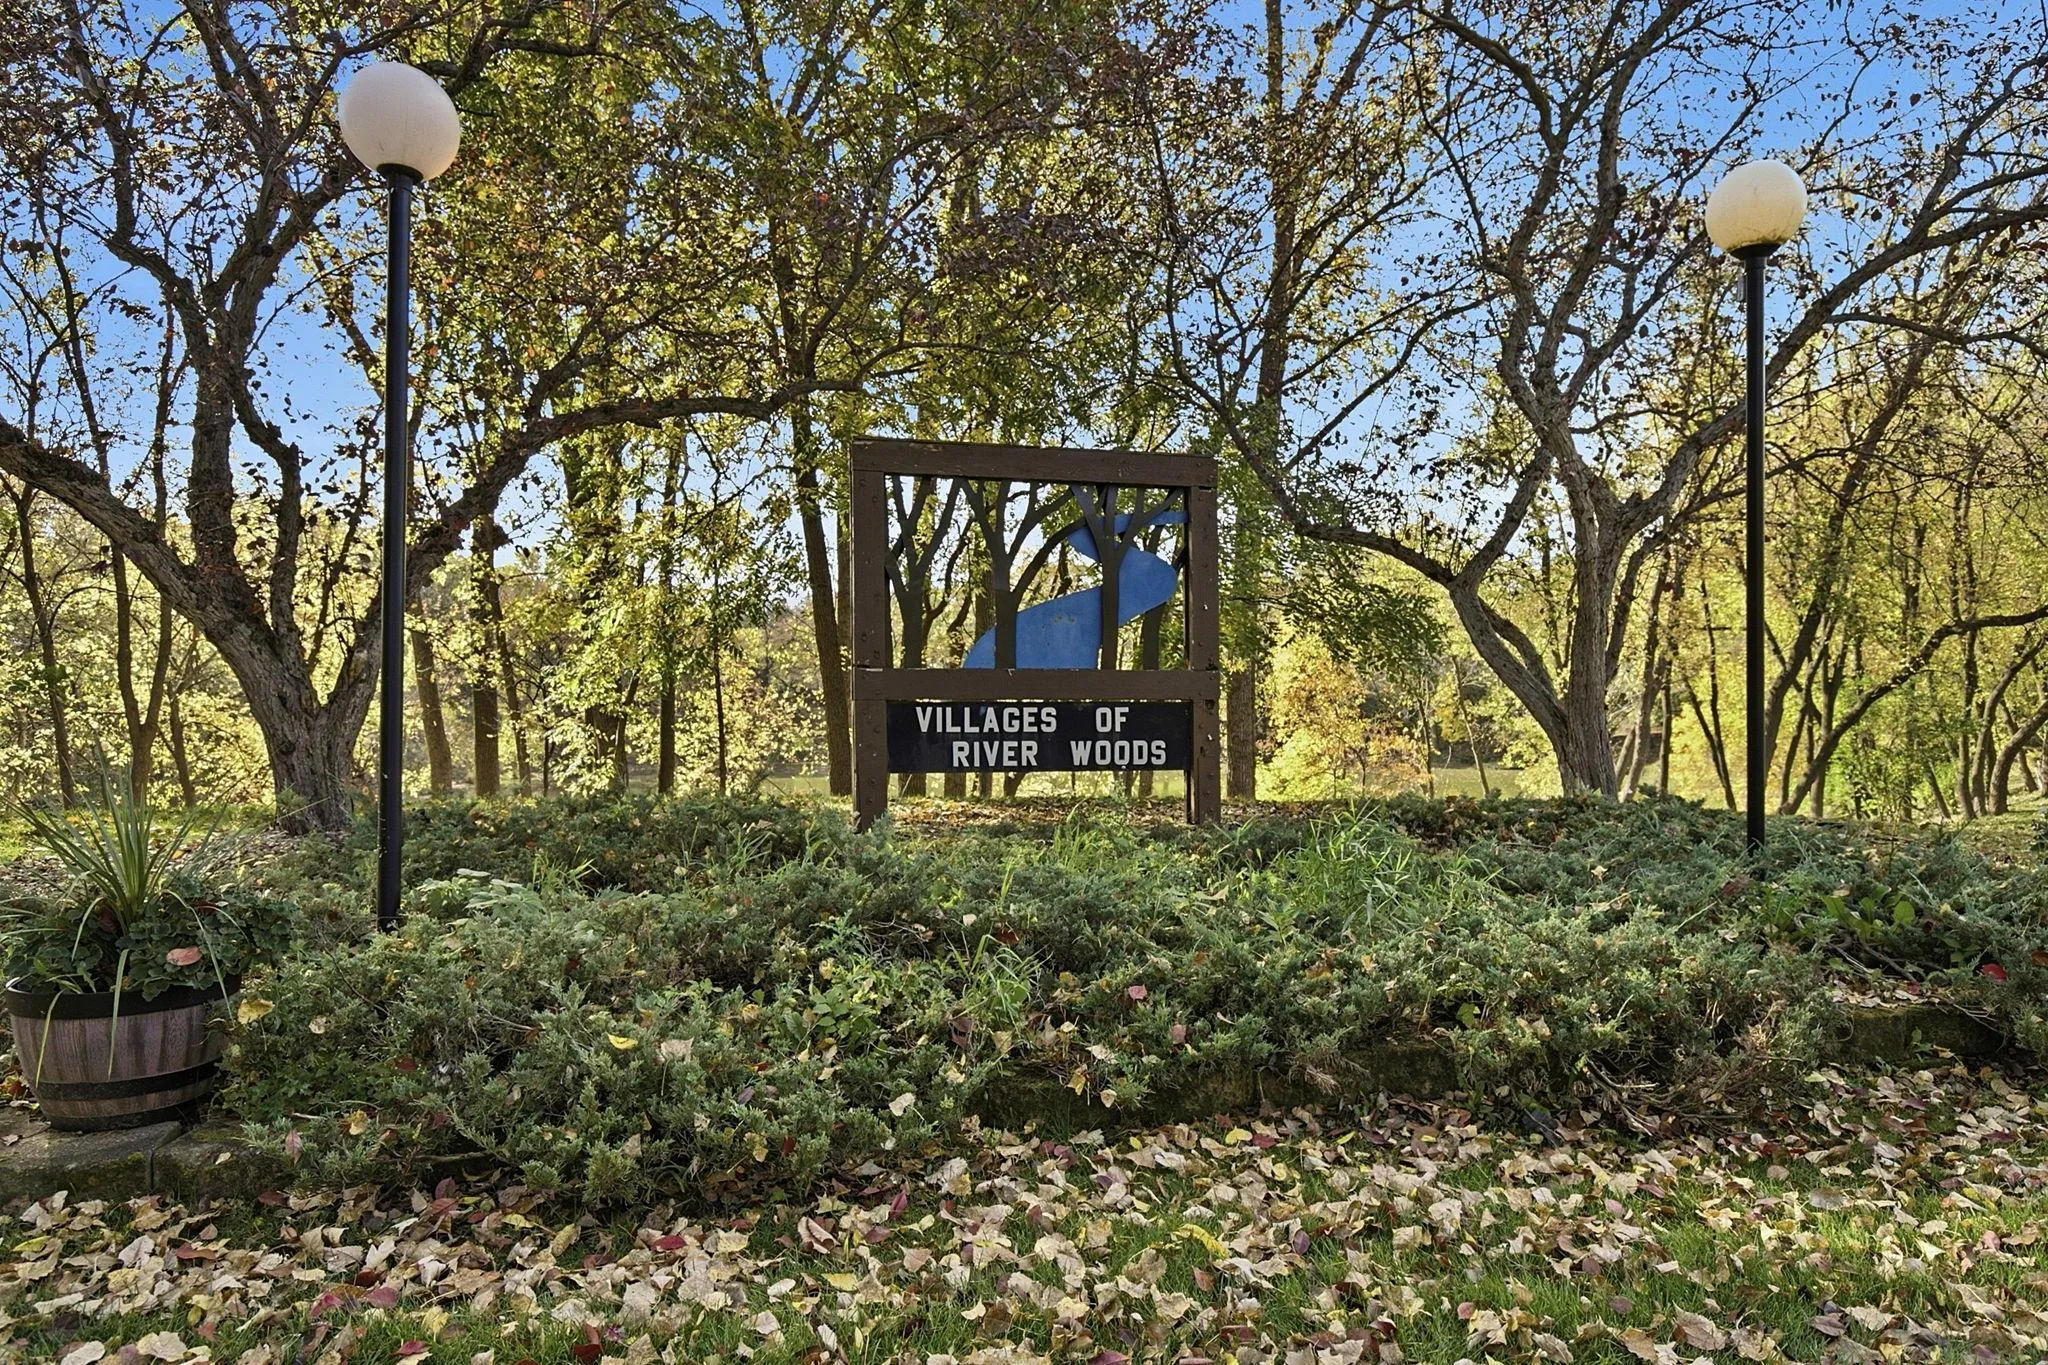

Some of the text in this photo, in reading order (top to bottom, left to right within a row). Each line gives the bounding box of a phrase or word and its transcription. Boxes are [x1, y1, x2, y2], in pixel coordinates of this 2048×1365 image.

[915, 706, 1130, 733] VILLAGES OF
[952, 740, 1166, 767] RIVER WOODS
